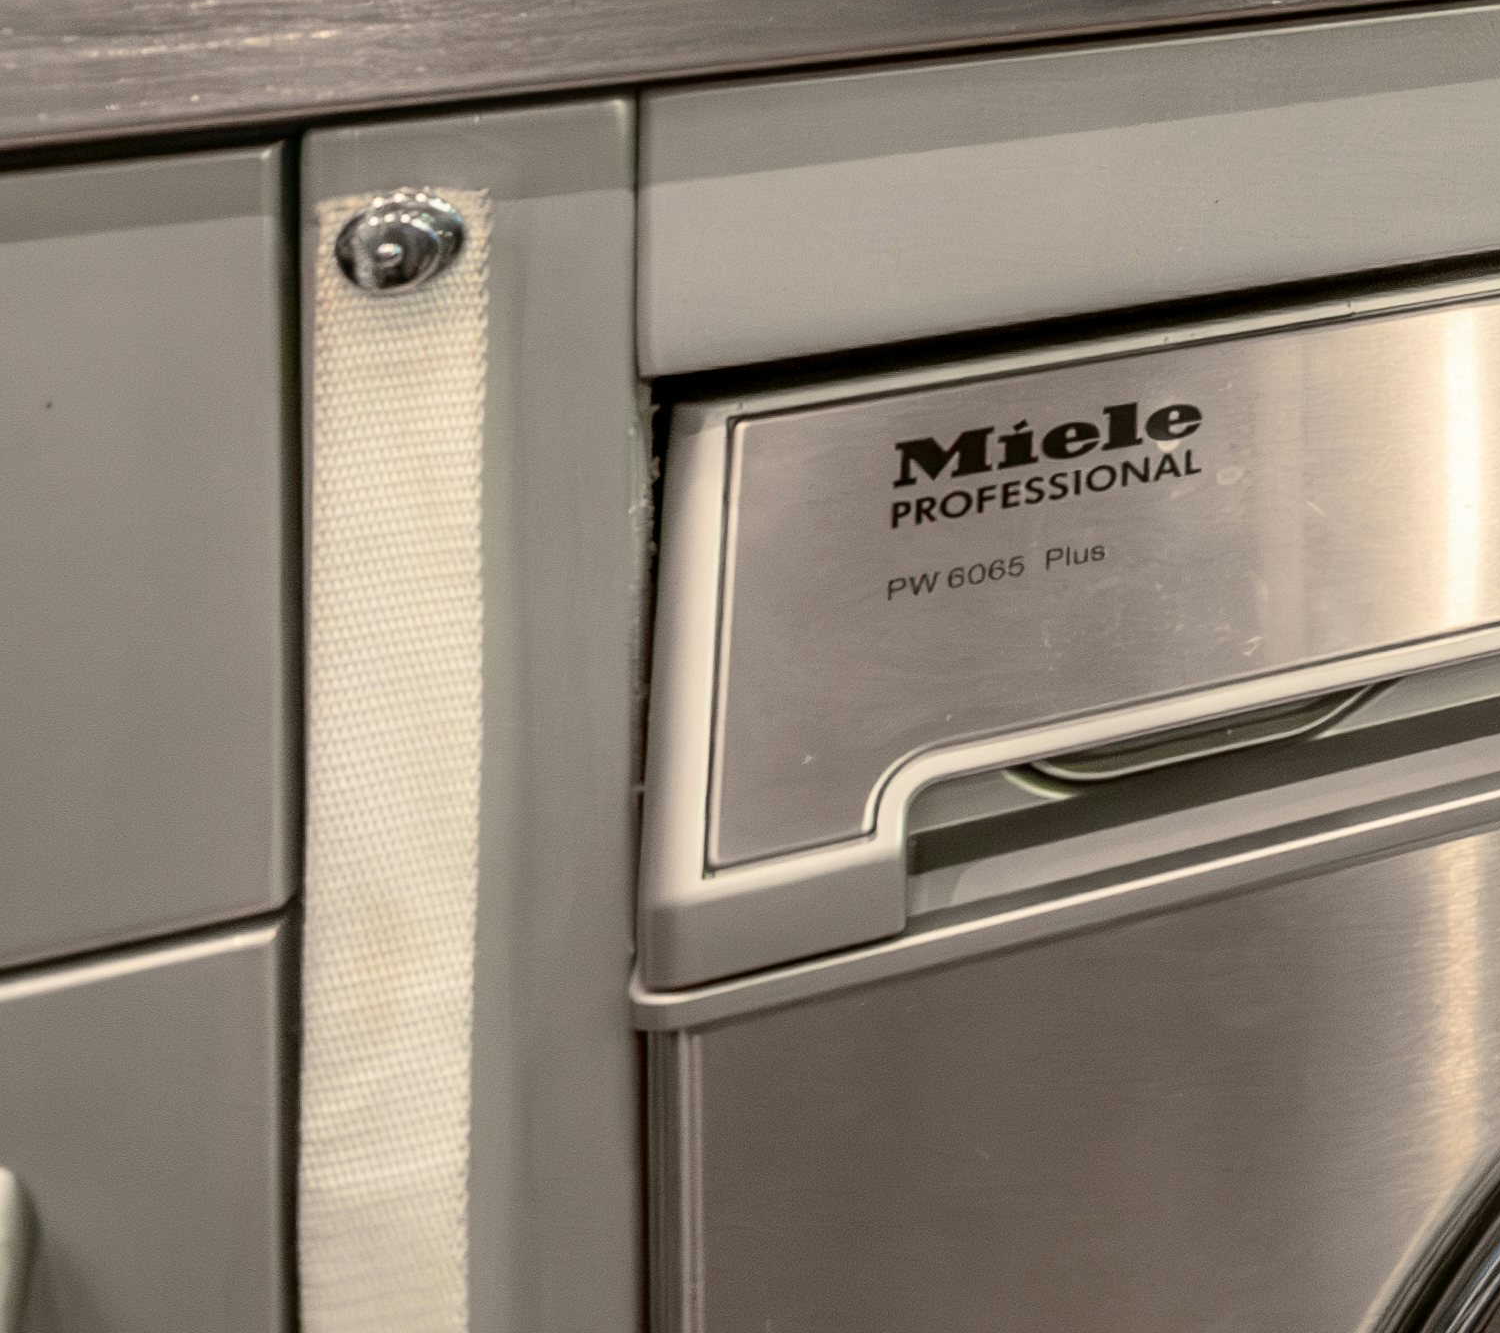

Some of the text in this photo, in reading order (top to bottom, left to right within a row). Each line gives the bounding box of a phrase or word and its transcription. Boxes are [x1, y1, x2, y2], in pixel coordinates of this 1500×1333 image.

[893, 402, 1203, 489] Miele
[890, 449, 1203, 530] PROFESSIONAL
[887, 544, 1106, 601] PW 6065 Plus
